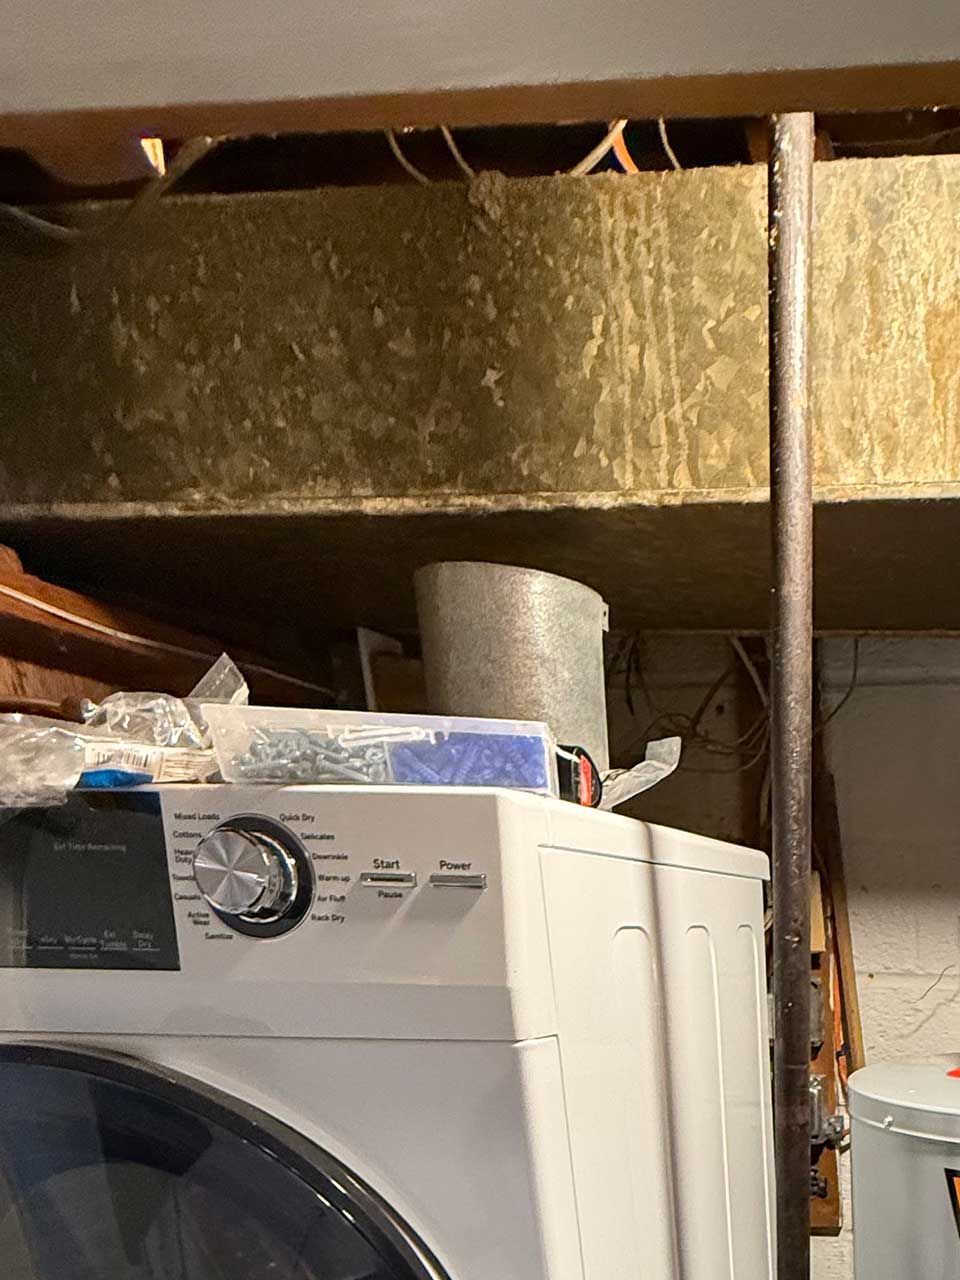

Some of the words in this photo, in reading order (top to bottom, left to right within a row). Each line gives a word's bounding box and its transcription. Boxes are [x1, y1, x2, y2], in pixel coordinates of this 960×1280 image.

[280, 813, 298, 822] Quick
[300, 814, 316, 823] Dry
[373, 858, 400, 869] Start
[440, 860, 472, 870] Power
[378, 890, 403, 898] Pause
[331, 914, 345, 924] Dry
